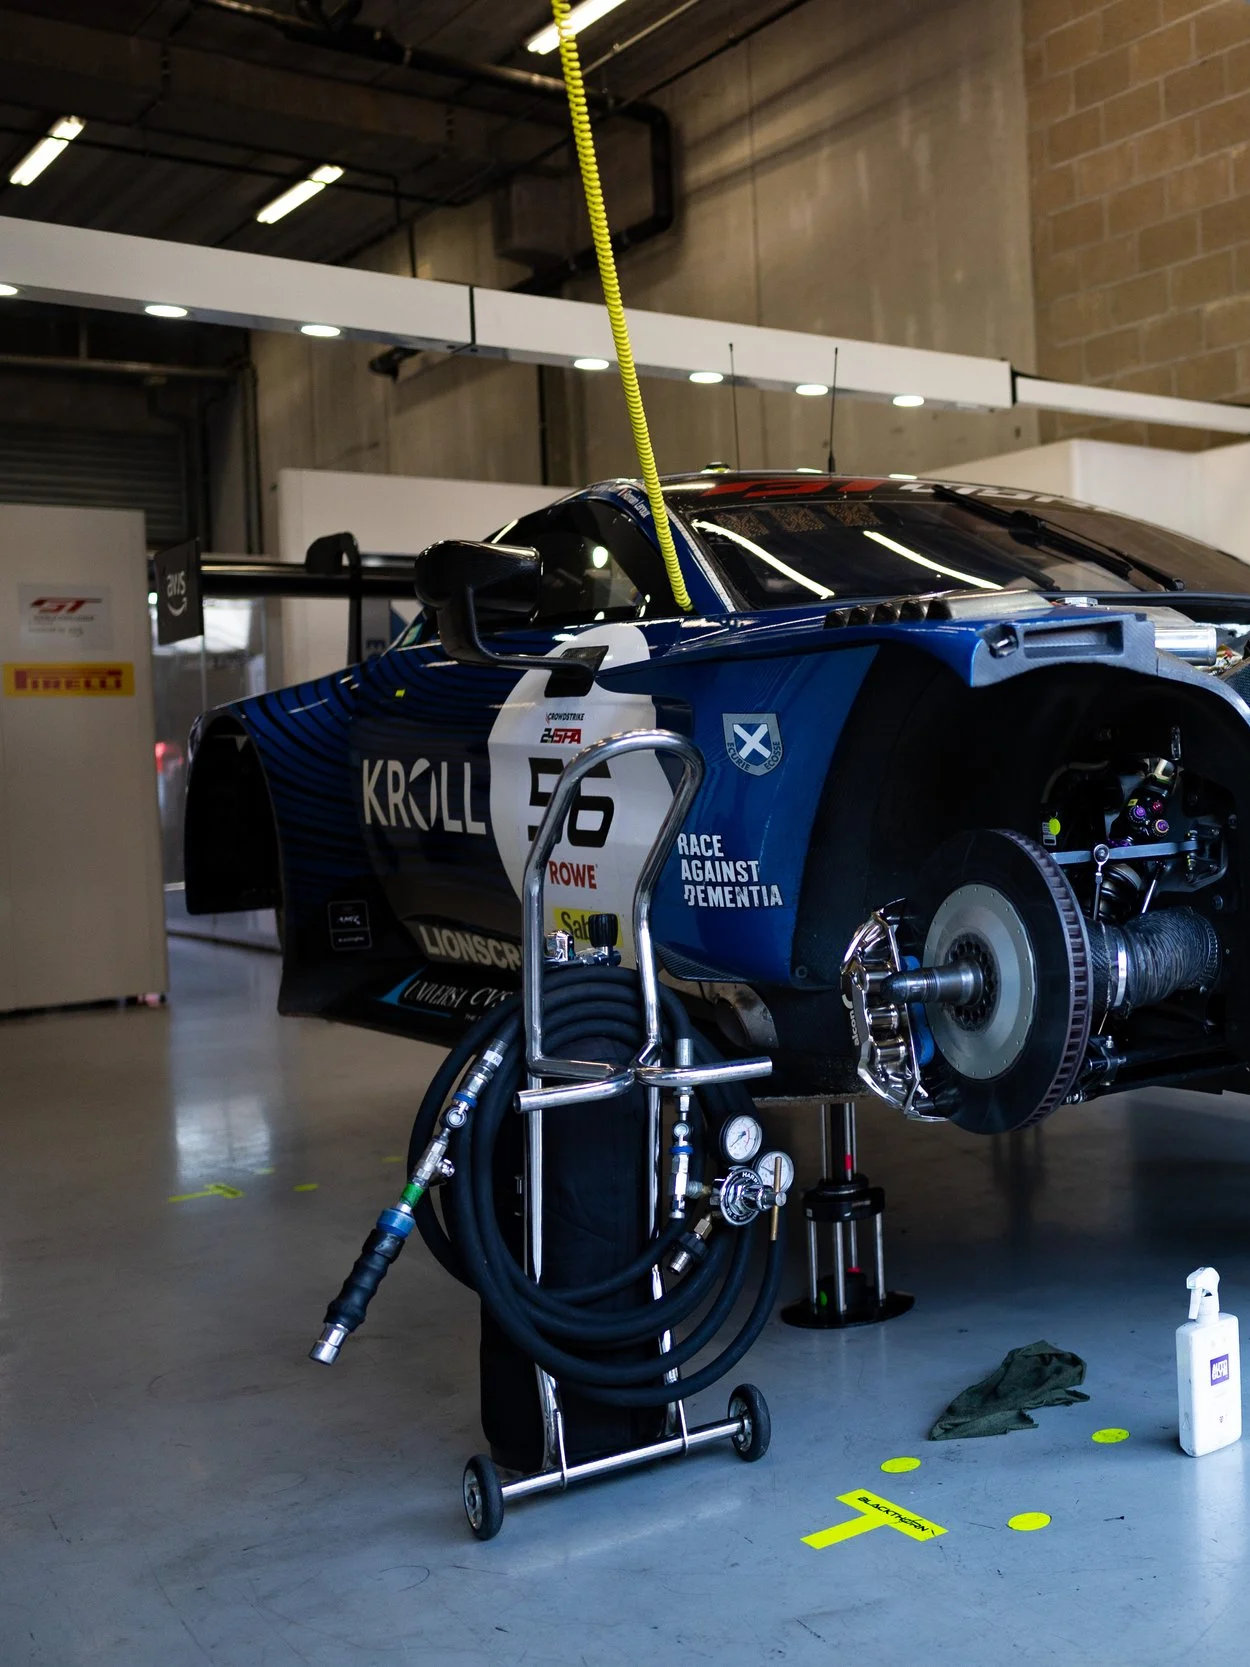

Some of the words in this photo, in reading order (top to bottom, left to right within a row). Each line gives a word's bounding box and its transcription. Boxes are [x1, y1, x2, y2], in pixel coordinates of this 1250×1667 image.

[15, 669, 123, 690] PIRELLI
[548, 712, 586, 721] CROWDSTRIKE
[727, 742, 751, 771] ECURIE
[764, 741, 780, 770] ECOSSE
[363, 758, 487, 835] KROLL
[528, 757, 615, 848] 56
[677, 833, 724, 857] RACE
[548, 860, 597, 889] ROWE
[681, 859, 759, 883] AGAINST
[684, 884, 783, 908] DEMENTIA
[419, 925, 523, 971] LIONSCR
[850, 1010, 859, 1046] alcon
[857, 1496, 929, 1532] BLACKTHORN
